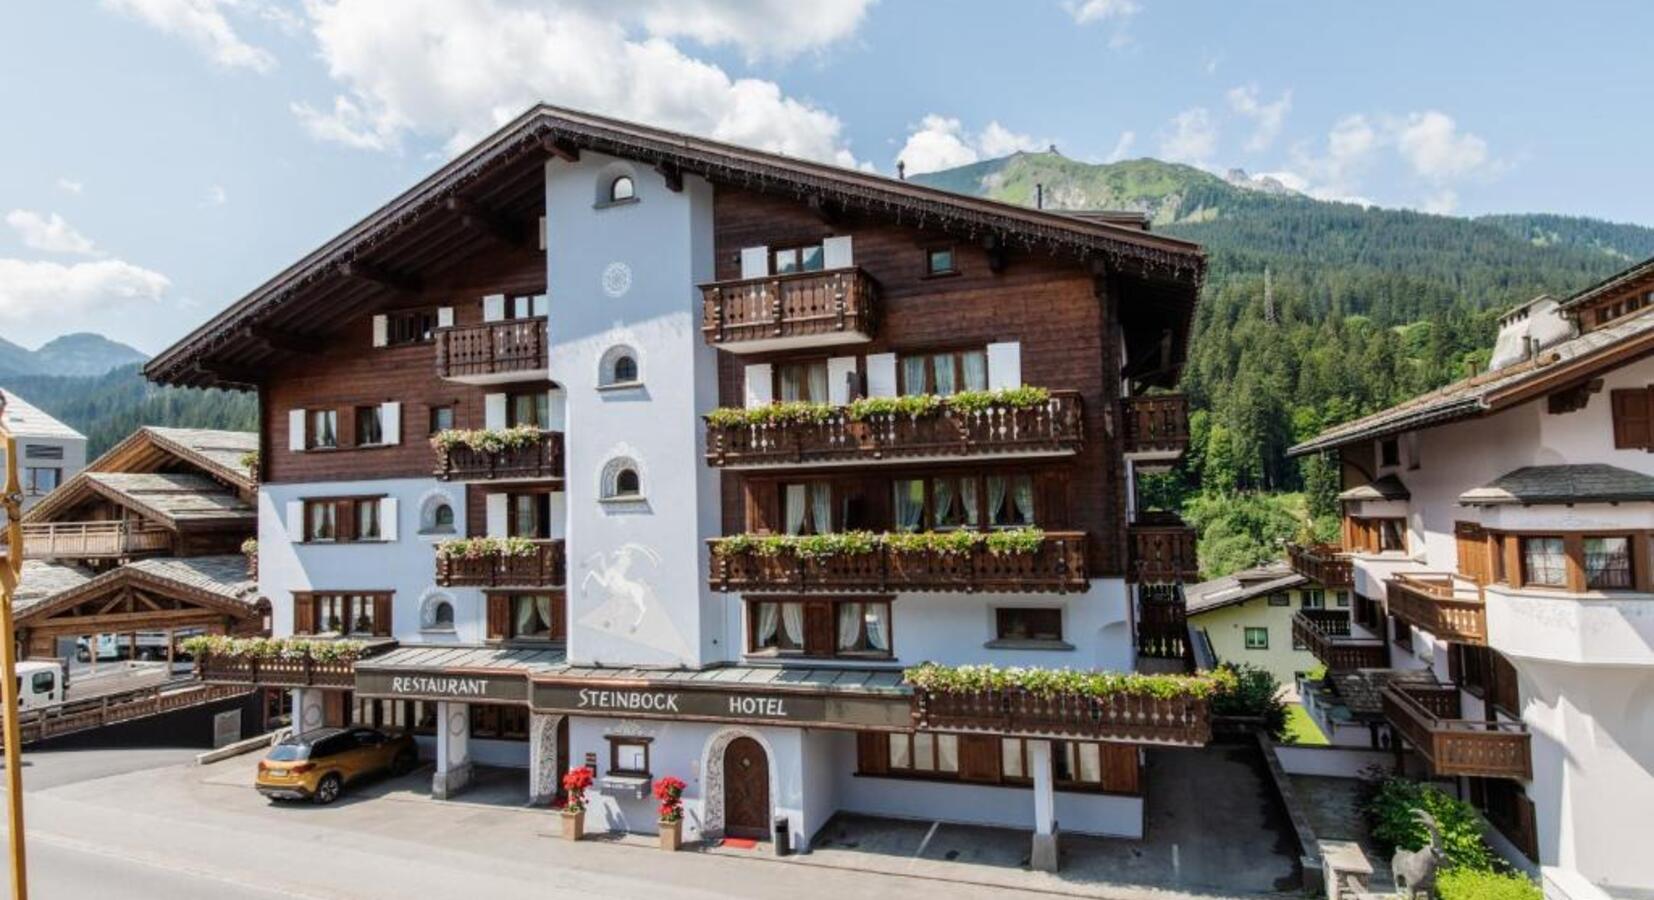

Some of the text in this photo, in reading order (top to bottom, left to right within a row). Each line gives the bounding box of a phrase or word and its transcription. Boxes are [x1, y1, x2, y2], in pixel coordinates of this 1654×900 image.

[391, 676, 489, 695] RESTAURANT
[577, 688, 788, 716] STEINBOCK HOTEL
